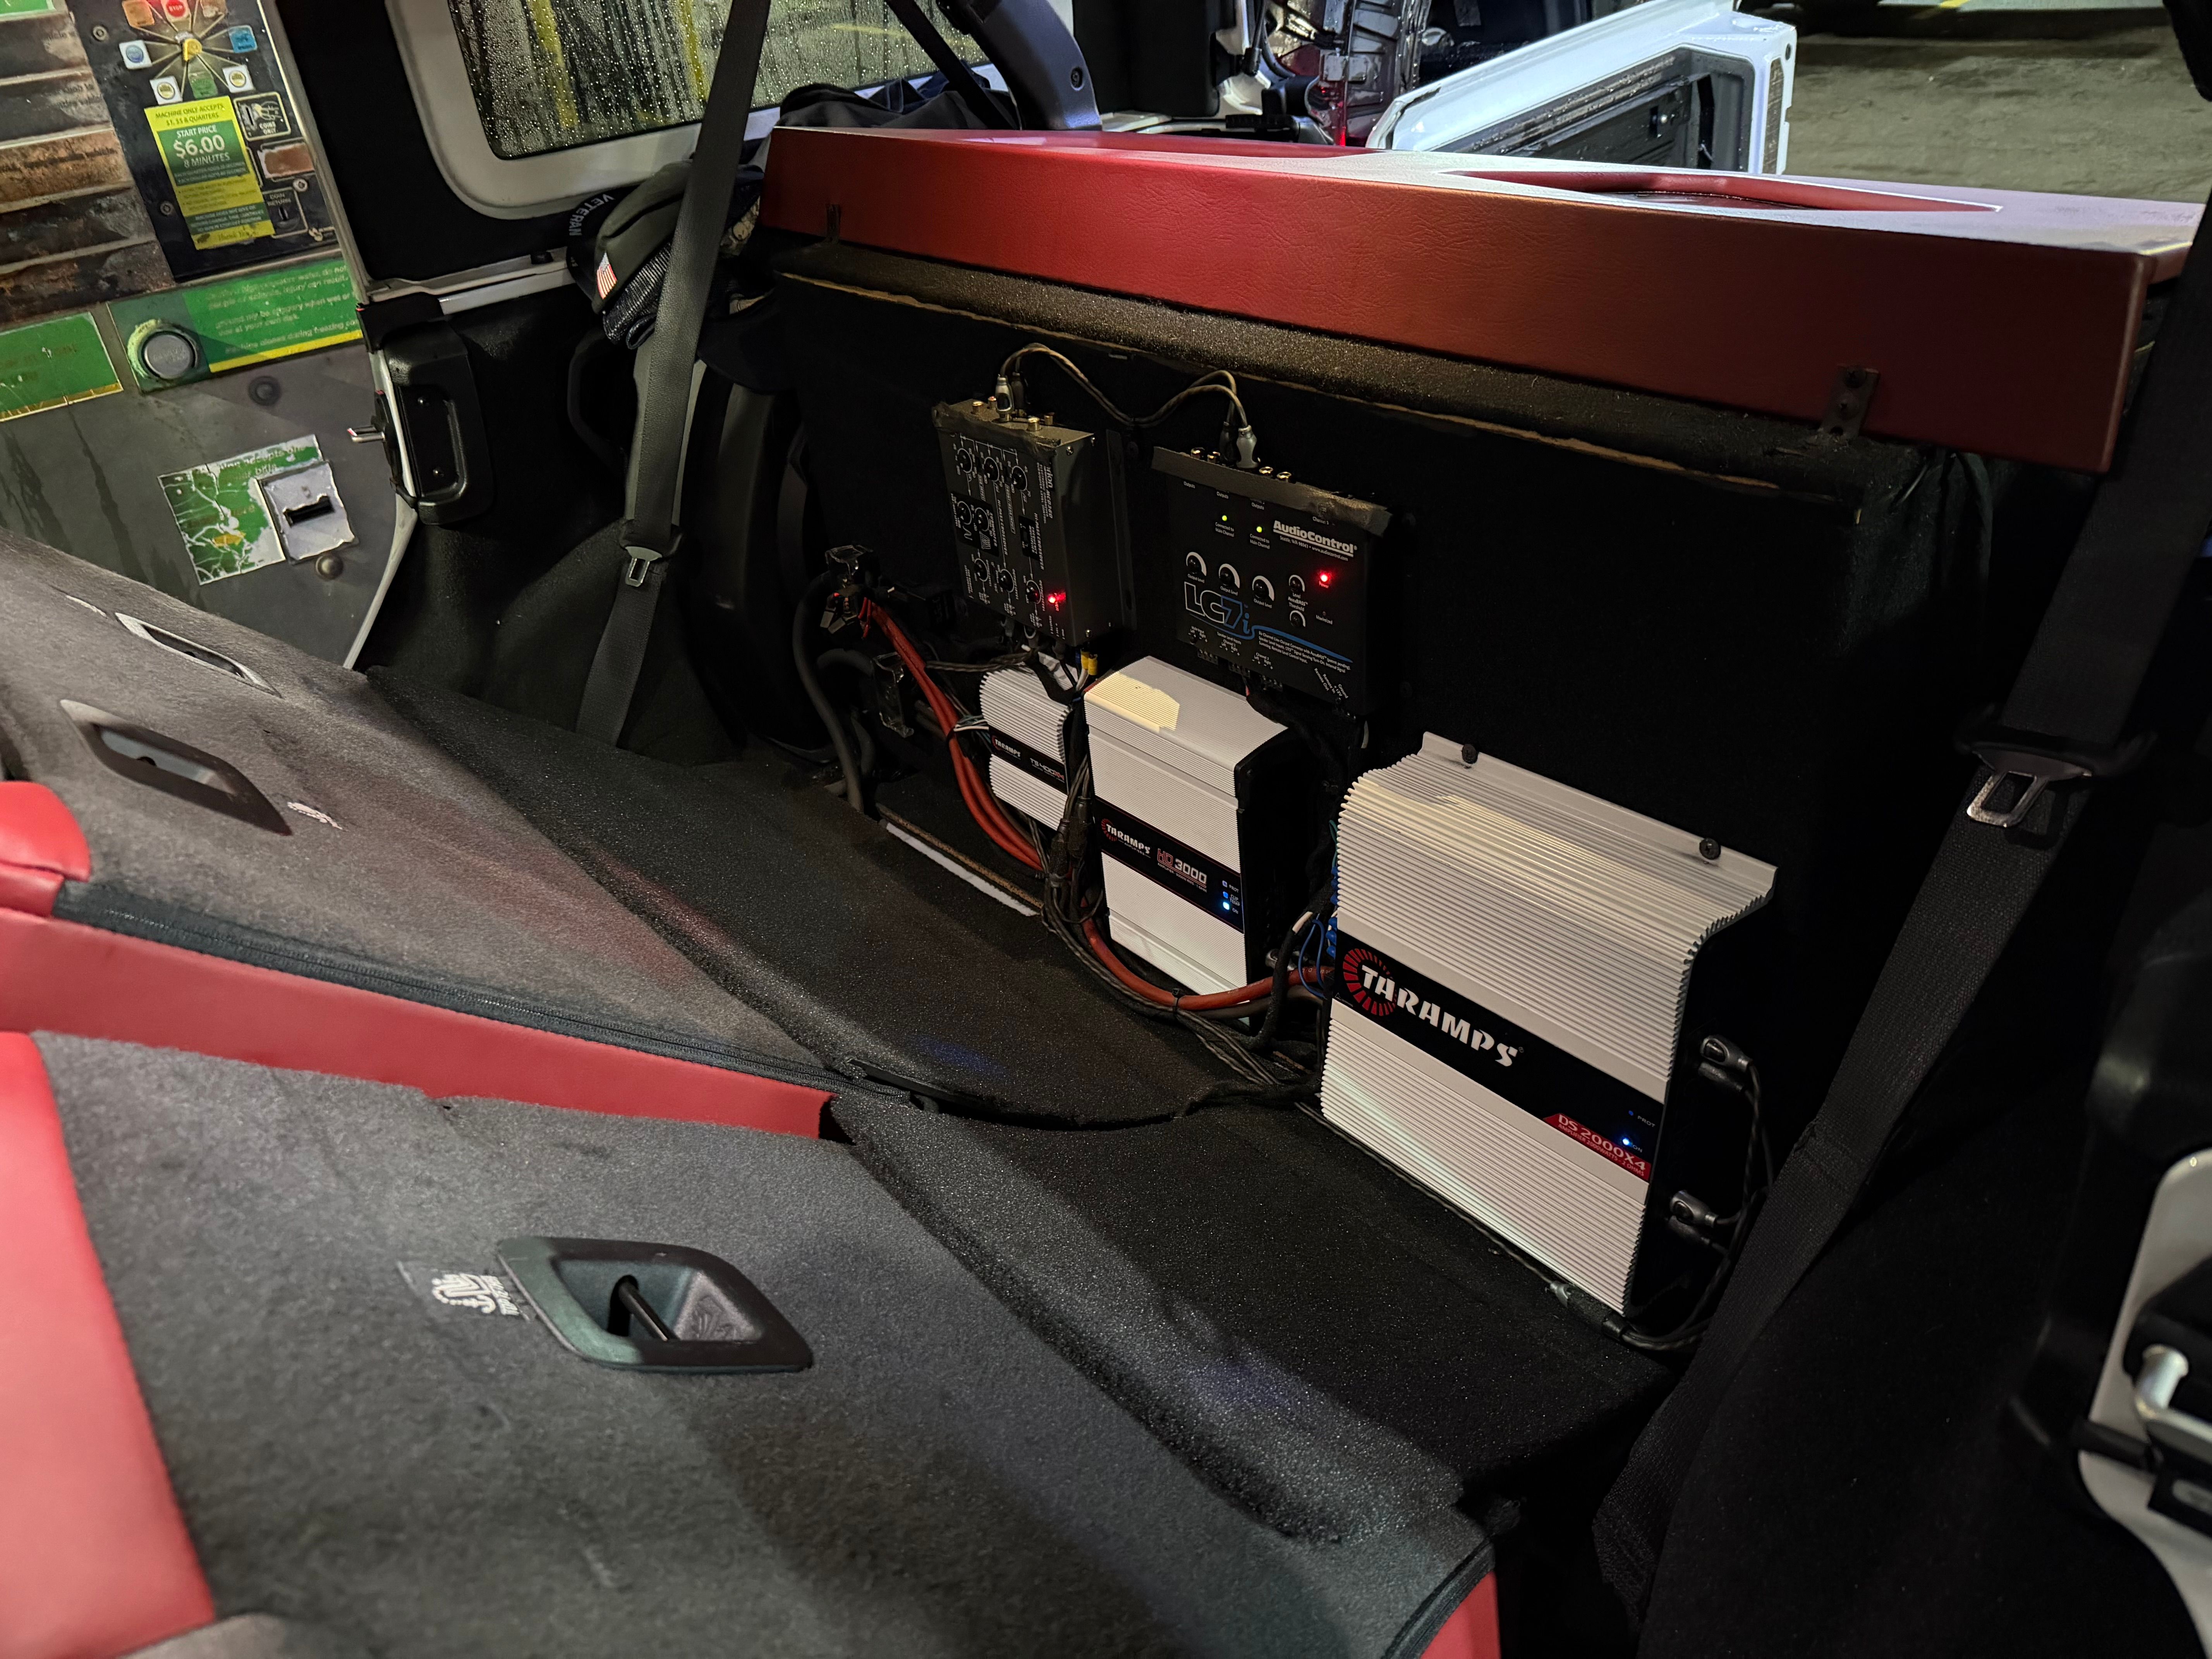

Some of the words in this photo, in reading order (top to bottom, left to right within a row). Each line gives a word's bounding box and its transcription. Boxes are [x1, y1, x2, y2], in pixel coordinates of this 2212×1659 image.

[155, 110, 182, 118] MACHINE
[199, 103, 224, 112] ACCEPTS
[189, 113, 219, 122] QUARTERS
[176, 128, 197, 138] START
[198, 125, 217, 135] PRICE
[173, 134, 225, 159] $6.00
[184, 160, 190, 168] 8
[191, 152, 230, 167] MINUTES
[568, 194, 616, 236] VETERAN
[989, 512, 998, 547] SUBWOOFER
[1215, 522, 1230, 531] Connected
[1250, 534, 1266, 543] Connected
[1037, 536, 1045, 570] CROSSOVER
[1289, 602, 1305, 611] Threshold
[1290, 643, 1304, 651] Converter
[1314, 668, 1324, 683] Remote
[1322, 673, 1333, 689] Remote
[1338, 684, 1348, 699] Ground
[994, 739, 1021, 757] TARAMPS
[1106, 824, 1151, 854] TARAMPS
[1157, 848, 1173, 866] HD
[1175, 858, 1207, 885] 3000
[1229, 884, 1239, 893] PROT
[1230, 897, 1240, 906] TEMP
[1361, 963, 1519, 1068] TARAMPS
[1637, 1115, 1656, 1128] PROT
[1558, 1114, 1578, 1132] DS
[1580, 1127, 1646, 1171] 2000X4
[1558, 1123, 1587, 1144] AMPLIFIER
[1626, 1163, 1645, 1177] OHMS
[1632, 1144, 1643, 1153] ON
